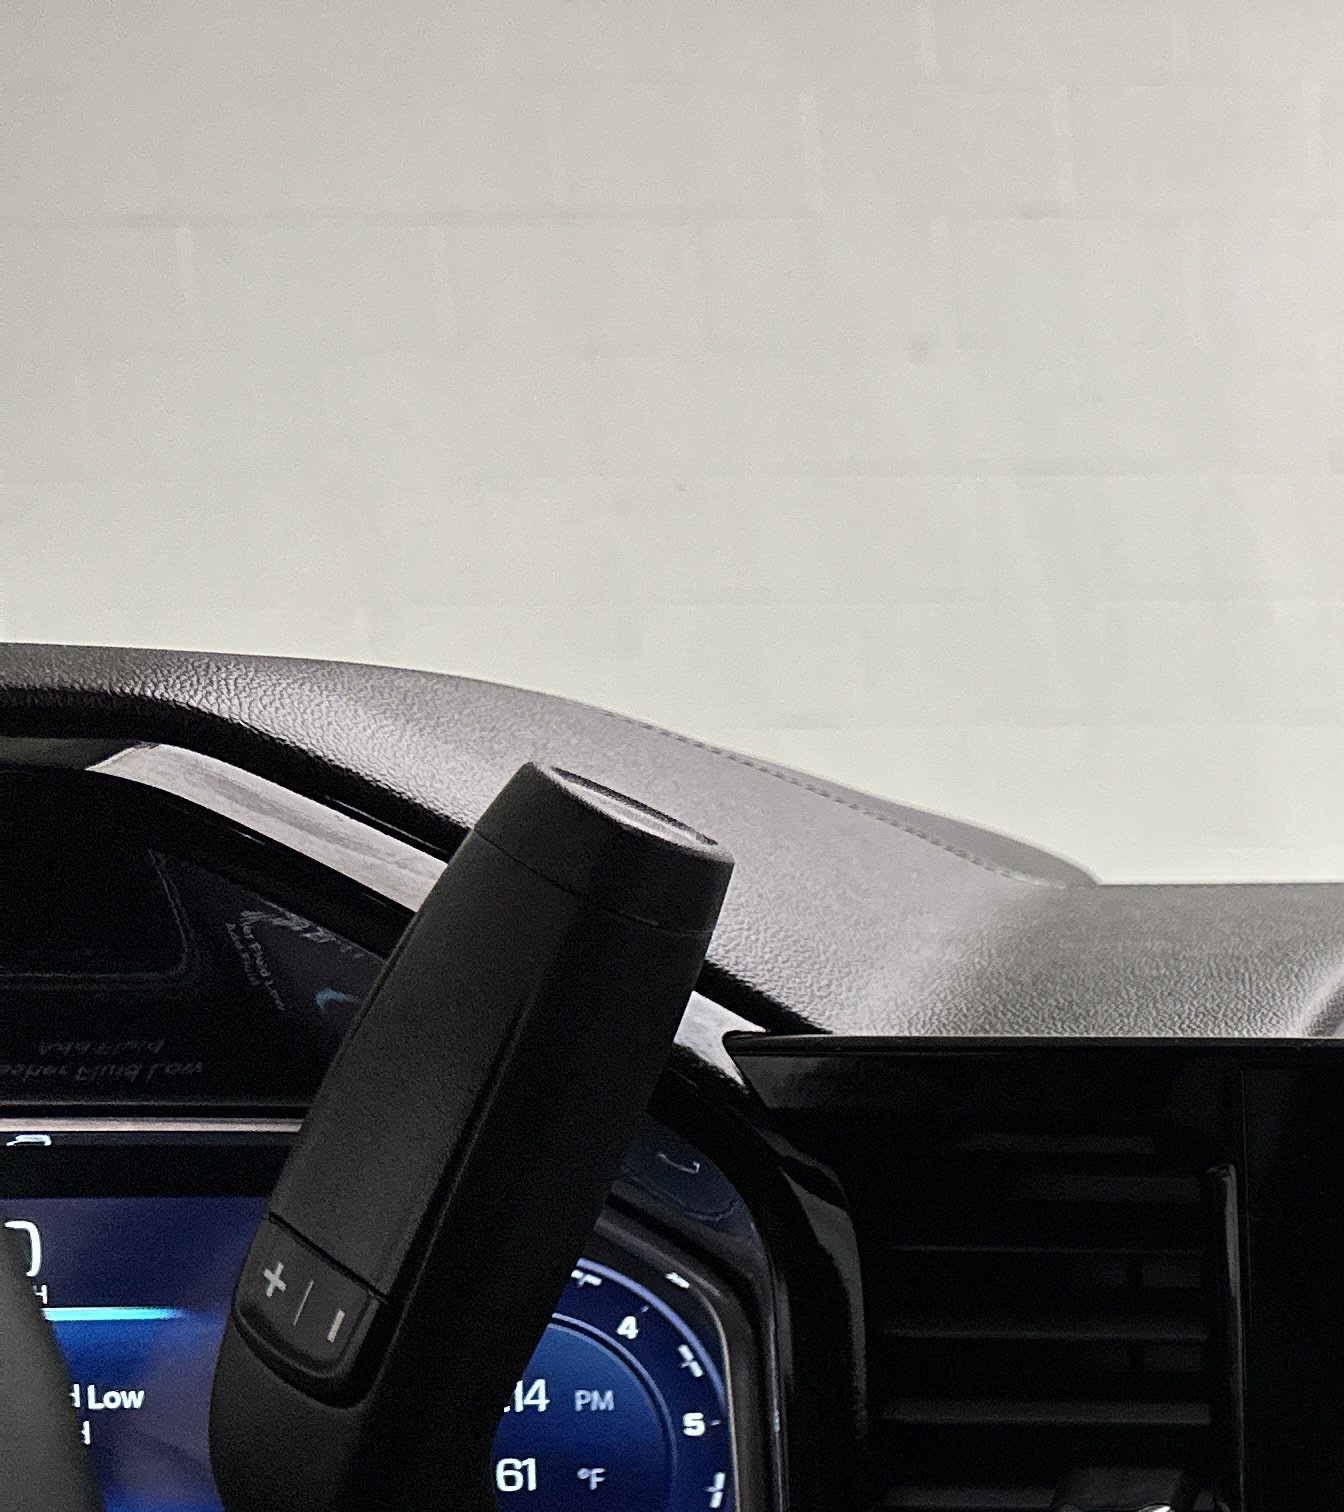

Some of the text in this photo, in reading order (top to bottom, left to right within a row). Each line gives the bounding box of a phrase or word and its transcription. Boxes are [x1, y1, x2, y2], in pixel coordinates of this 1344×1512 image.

[616, 1315, 640, 1340] 4
[87, 1384, 145, 1410] Low
[574, 1389, 615, 1412] PM
[682, 1412, 706, 1437] 5
[495, 1457, 537, 1492] 61
